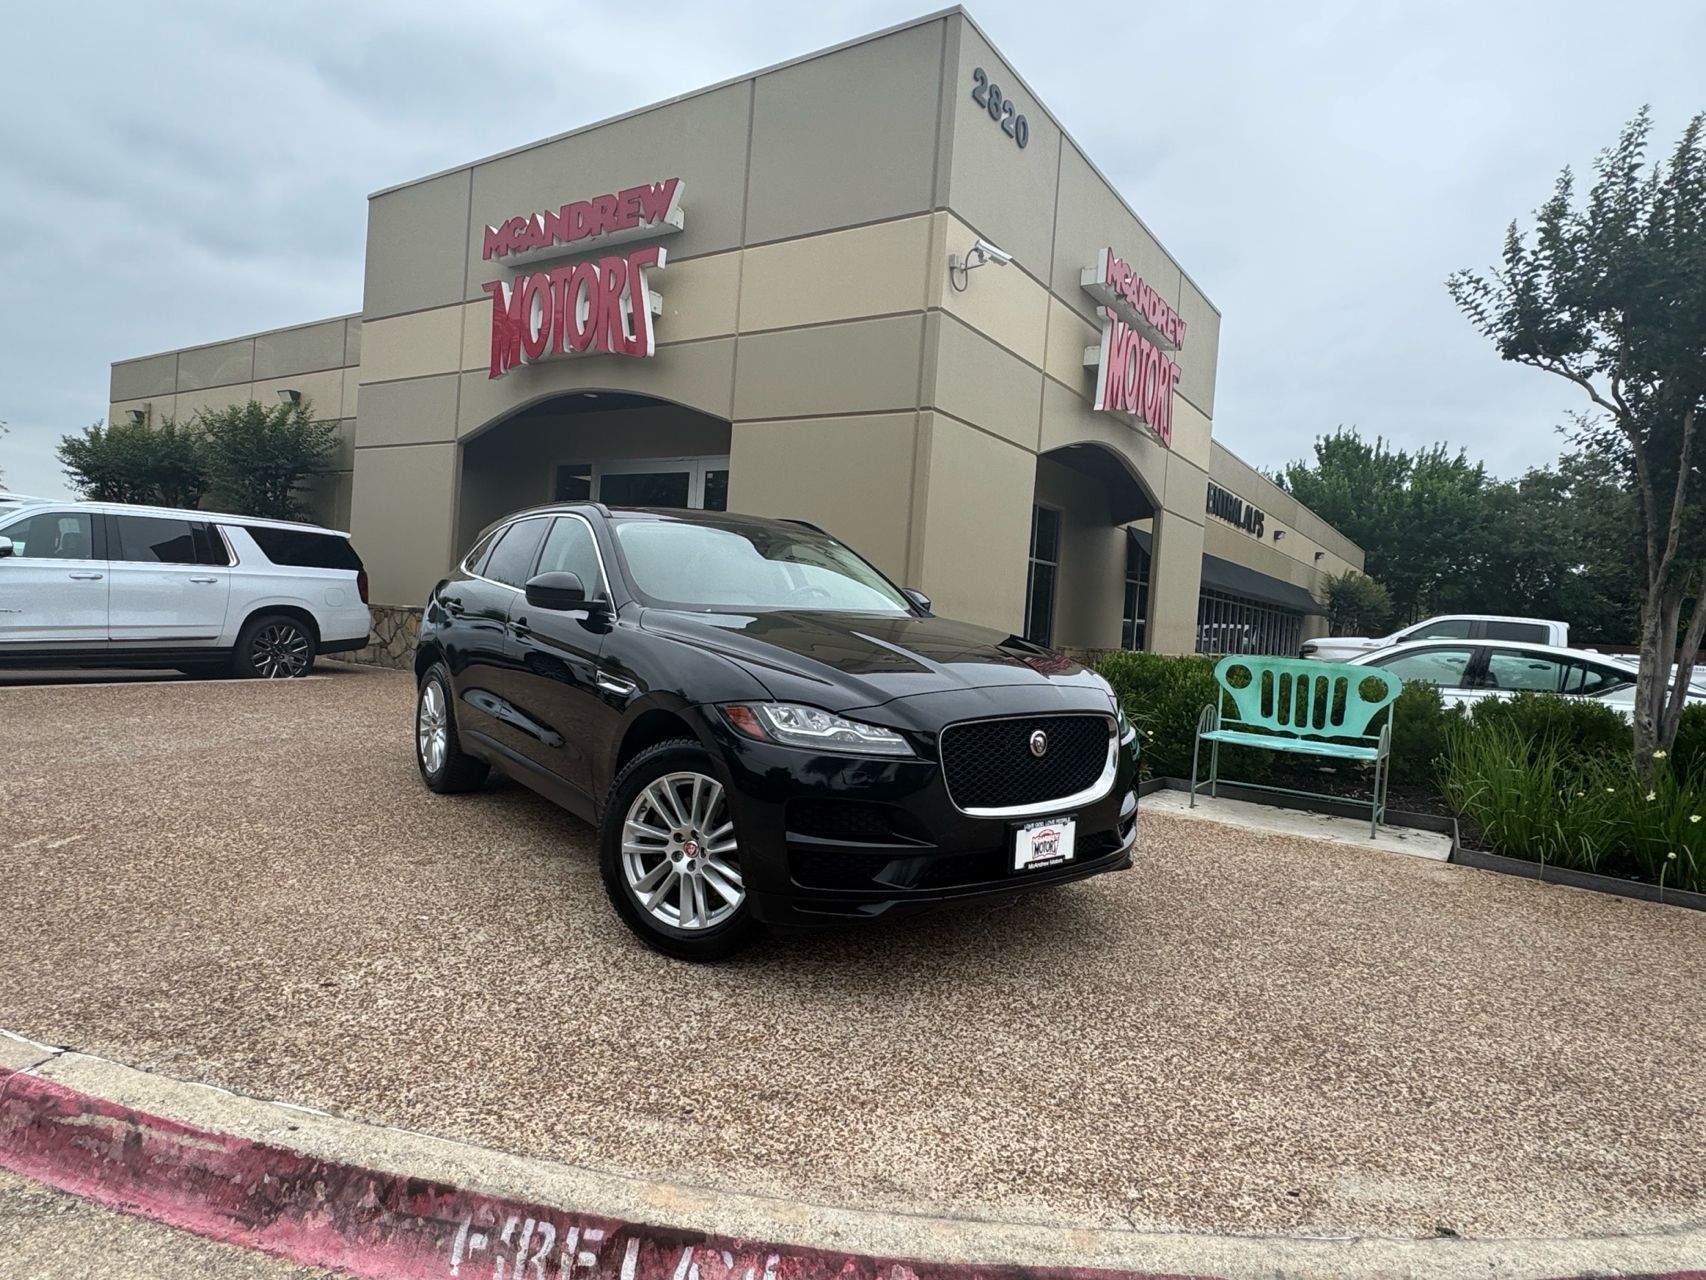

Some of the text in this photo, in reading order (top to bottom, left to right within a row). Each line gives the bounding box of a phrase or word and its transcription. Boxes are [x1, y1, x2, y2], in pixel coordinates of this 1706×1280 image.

[972, 67, 1029, 149] 2820
[481, 246, 660, 380] MOTORS
[1102, 305, 1182, 449] MOTORS
